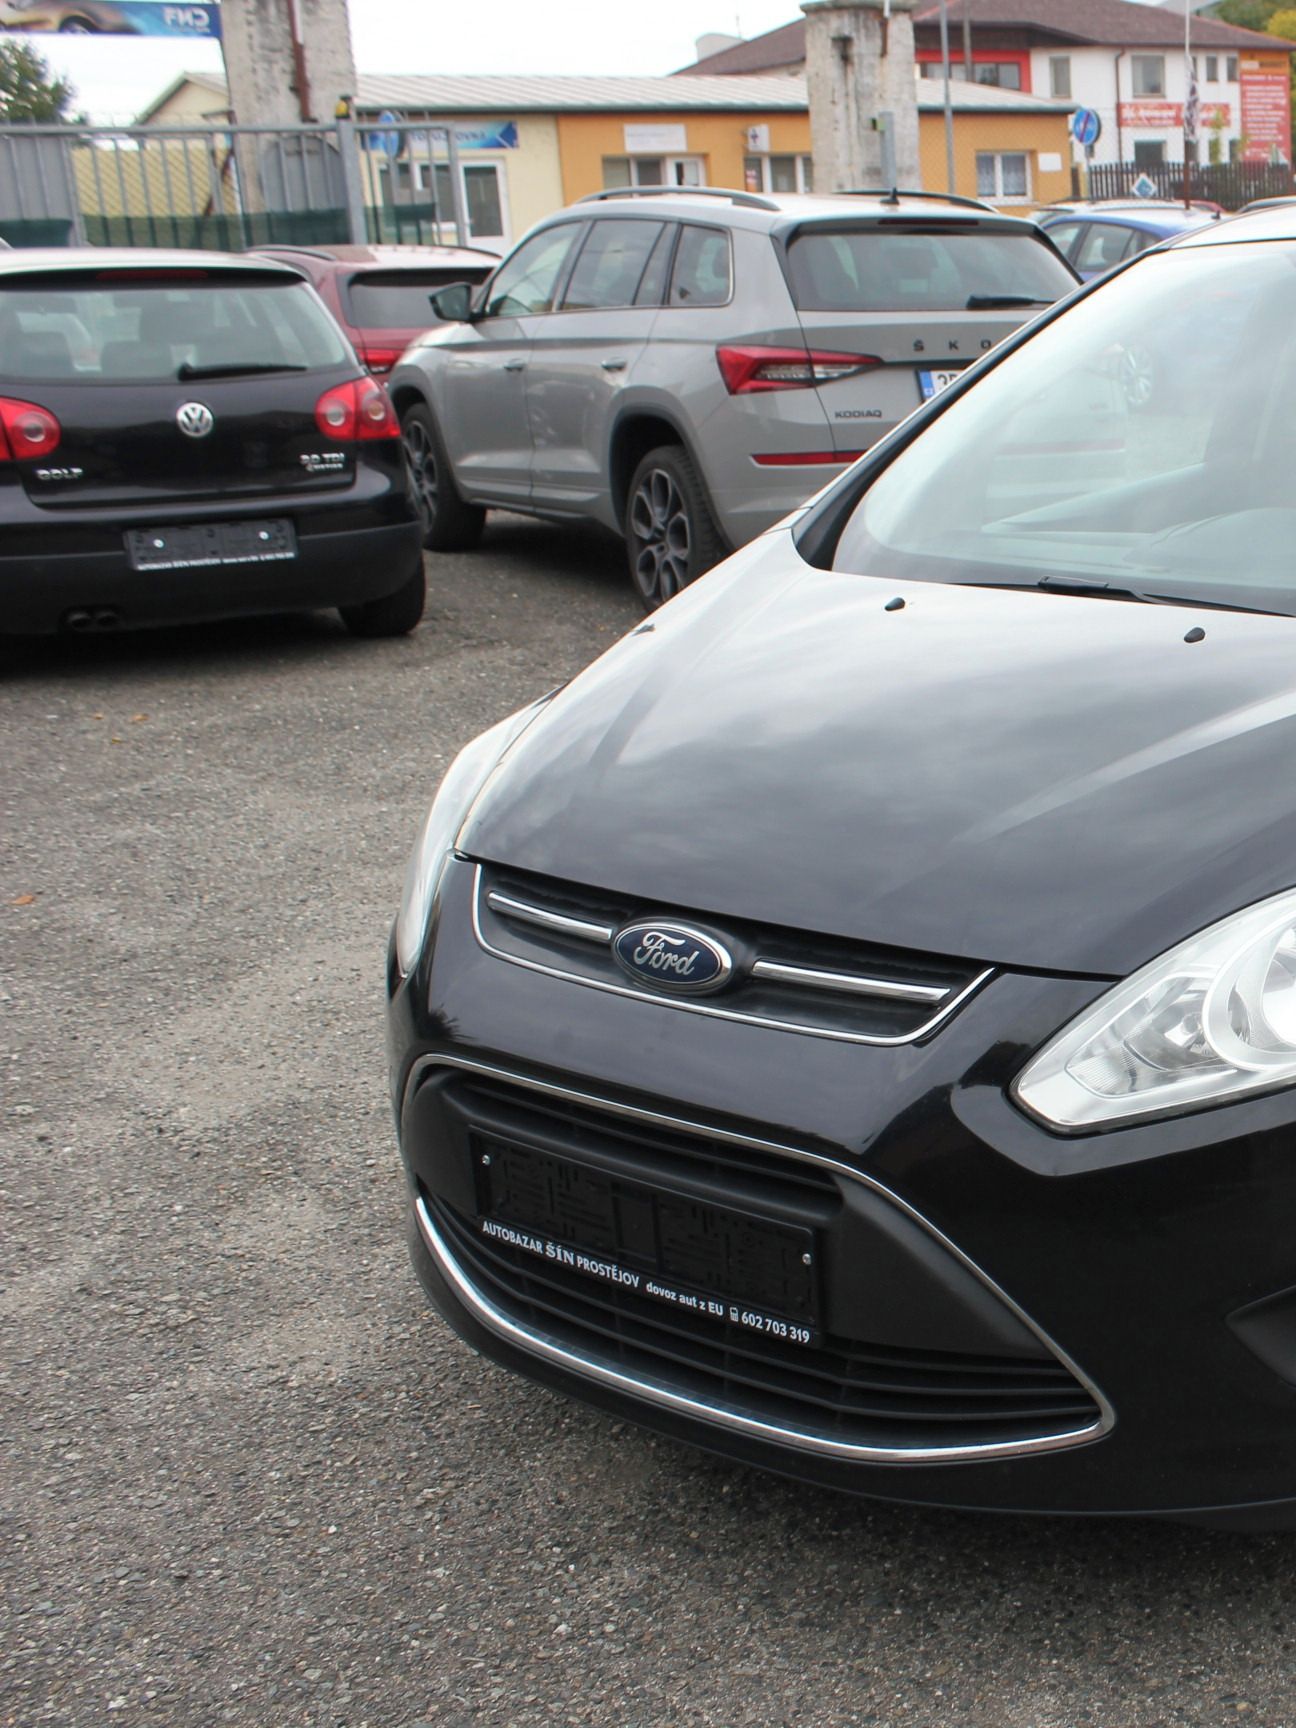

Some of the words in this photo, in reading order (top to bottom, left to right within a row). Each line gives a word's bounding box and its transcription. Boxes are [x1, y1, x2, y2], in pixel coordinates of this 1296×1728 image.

[834, 409, 882, 419] KODIAQ
[633, 931, 700, 976] Ford
[482, 1220, 543, 1254] AUTOBAZAR
[545, 1242, 575, 1266] ŠÍN
[576, 1256, 640, 1288] PROSTĚJOV
[645, 1281, 677, 1301] dovoz
[678, 1293, 698, 1308] aut
[698, 1300, 706, 1311] z
[708, 1301, 724, 1316] EU
[741, 1311, 763, 1330] 602
[764, 1318, 788, 1337] 703
[789, 1326, 810, 1344] 319
